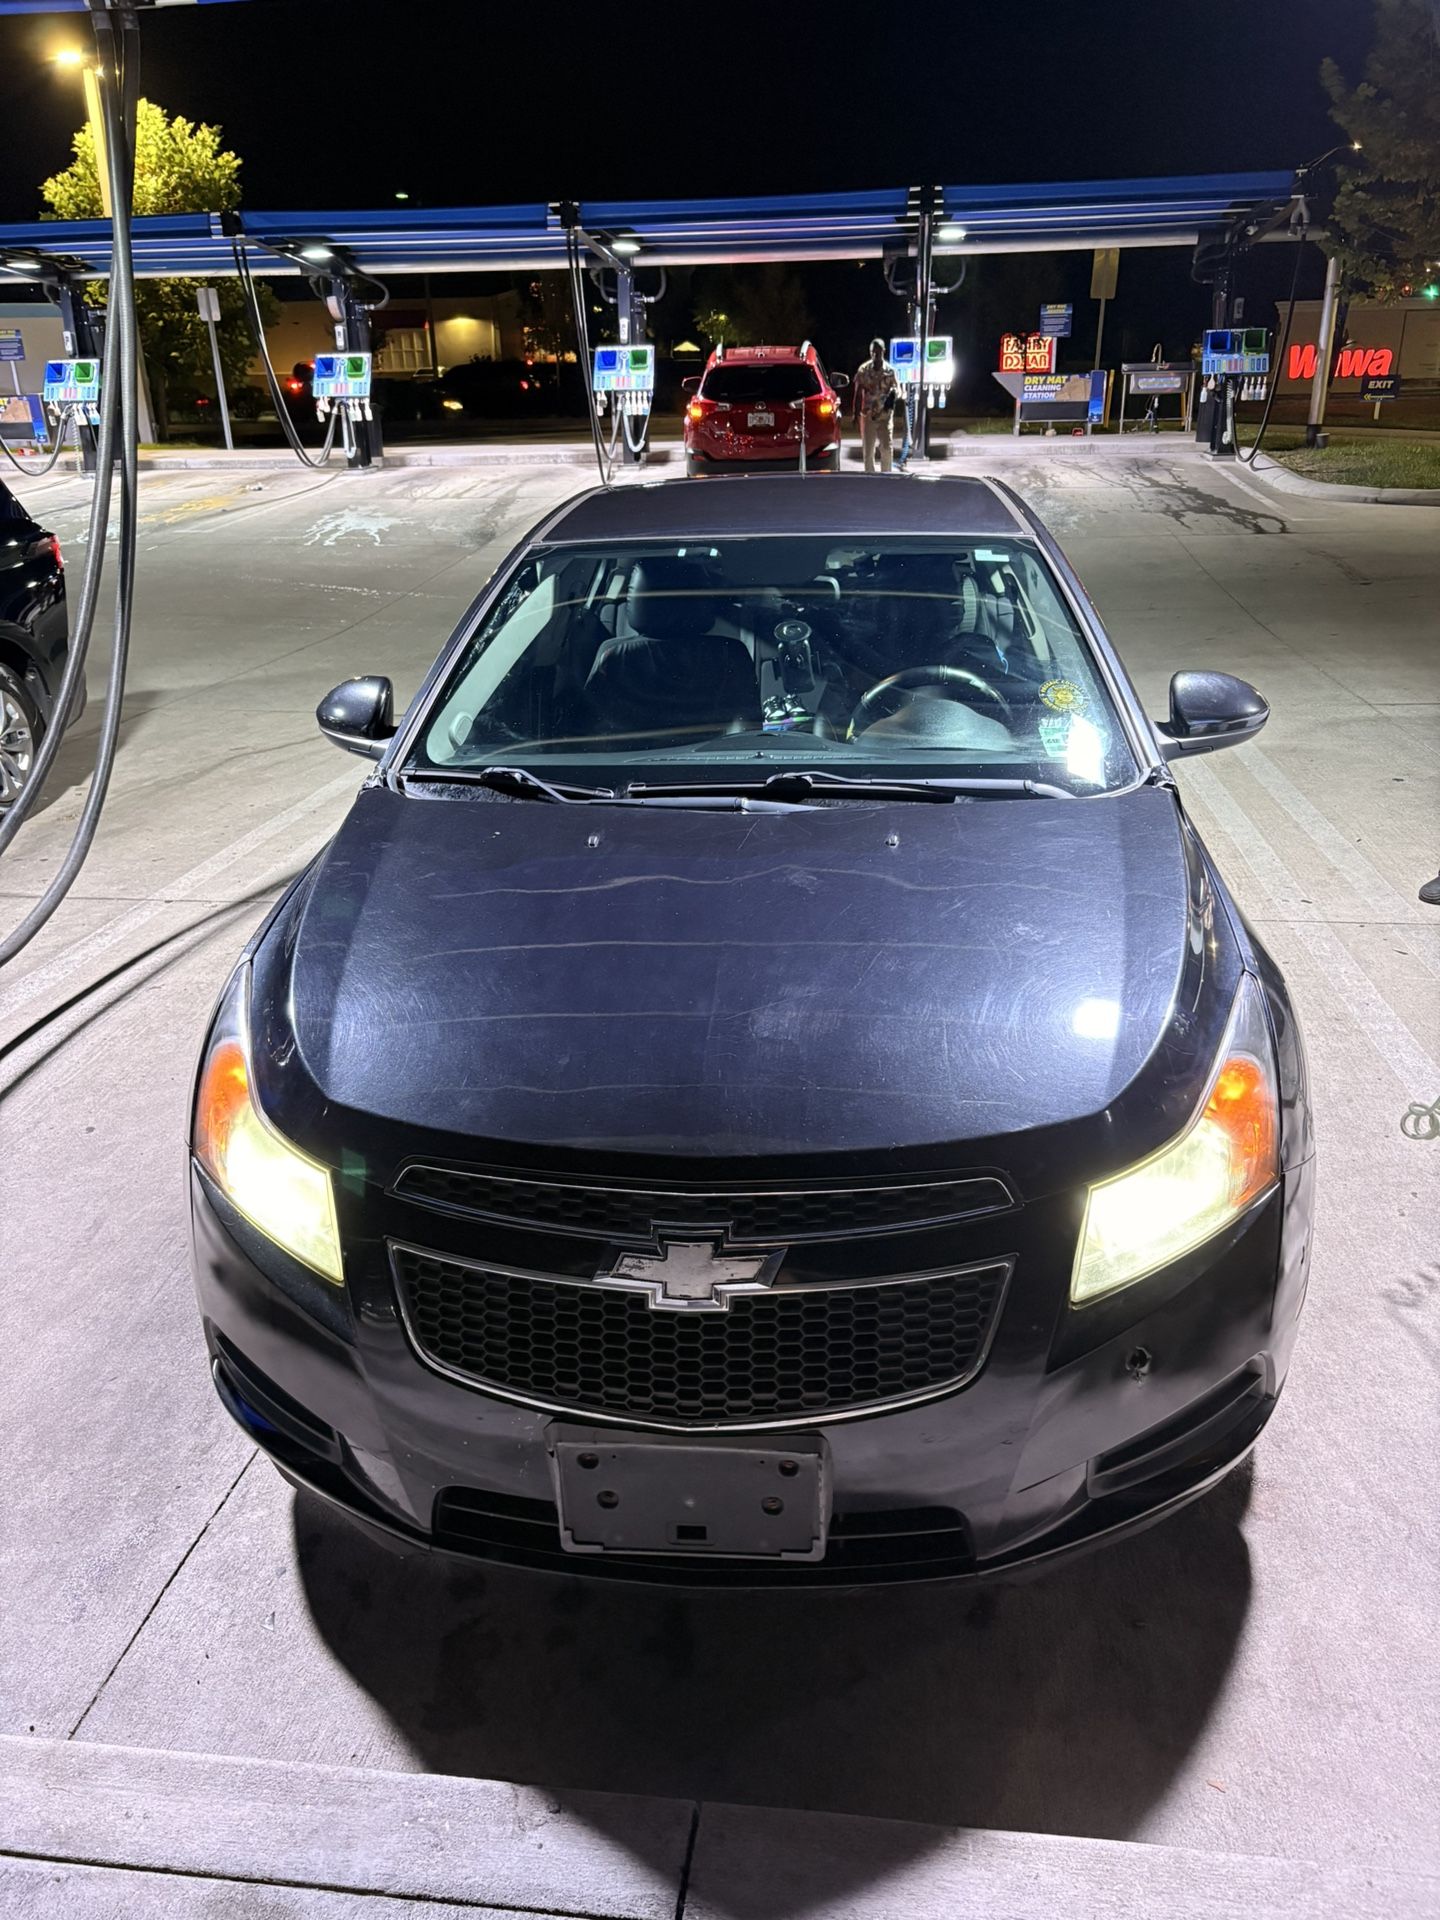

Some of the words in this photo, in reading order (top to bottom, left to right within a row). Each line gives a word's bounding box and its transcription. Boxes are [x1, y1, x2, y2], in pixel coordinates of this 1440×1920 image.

[1003, 354, 1049, 369] DOLAR
[1289, 344, 1392, 379] Wwa
[1024, 376, 1046, 385] DRY
[1046, 376, 1068, 384] MAT
[1367, 380, 1394, 389] EXIT
[1023, 392, 1055, 400] STATION
